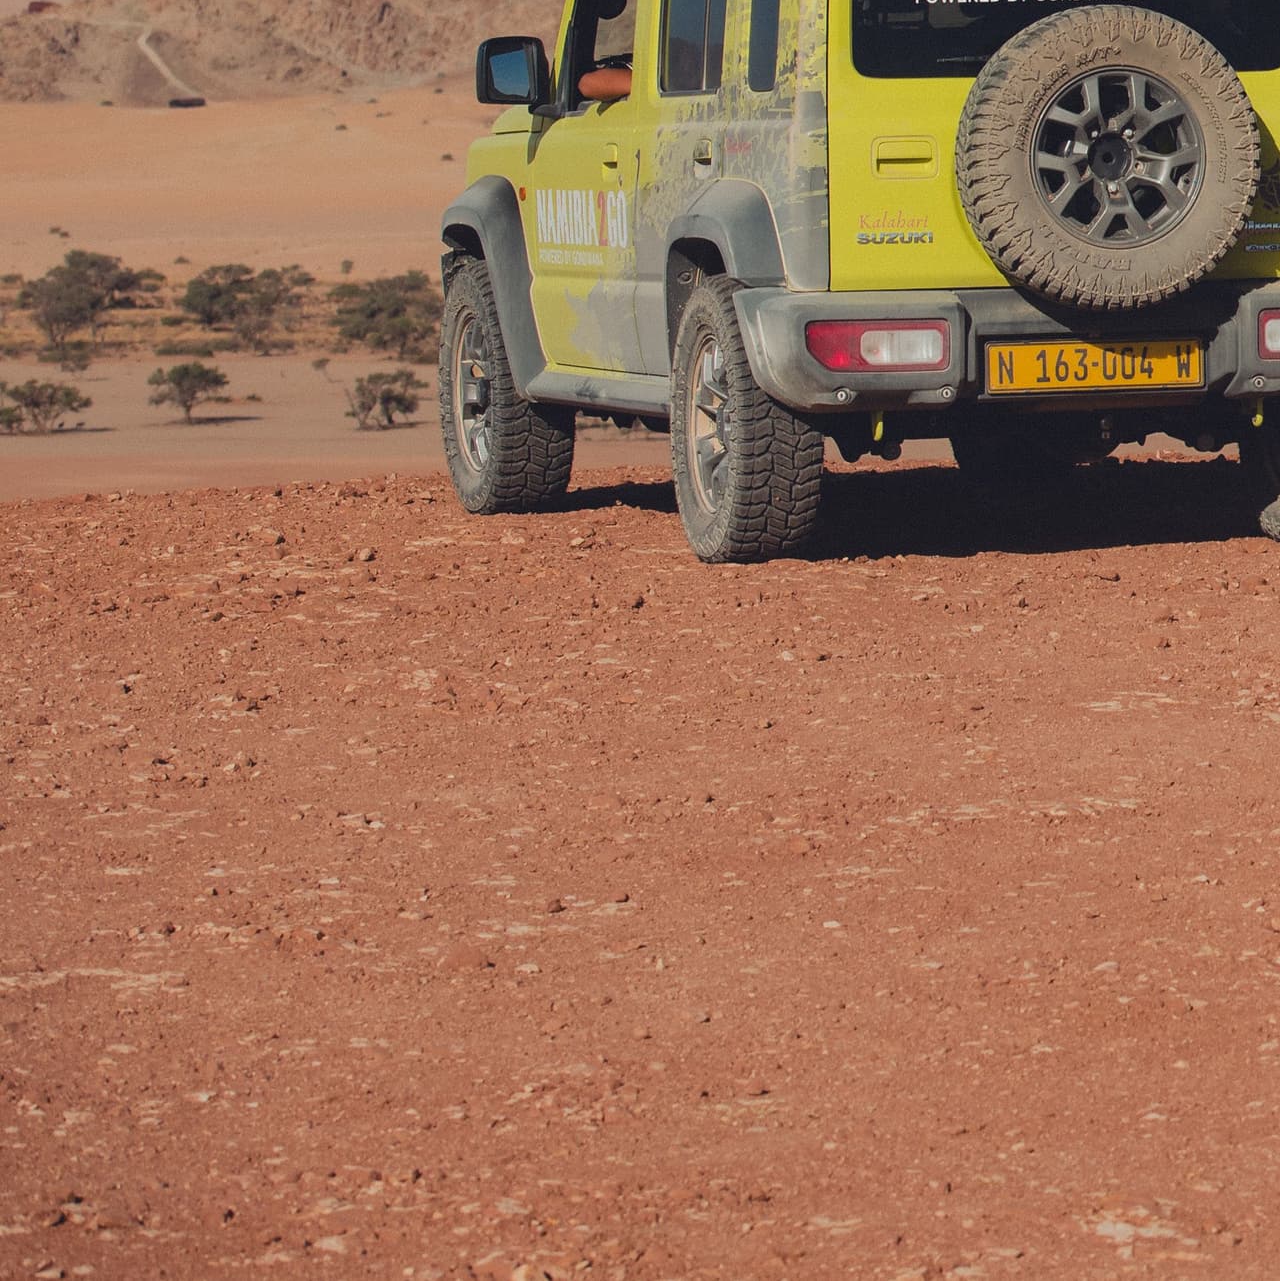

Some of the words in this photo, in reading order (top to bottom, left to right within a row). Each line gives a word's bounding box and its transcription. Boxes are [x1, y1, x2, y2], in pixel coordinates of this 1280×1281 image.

[536, 189, 628, 248] NAMIBIA2GO
[859, 210, 929, 229] Kalahari
[857, 232, 934, 245] SUZUKI
[998, 350, 1014, 384] N
[1036, 346, 1154, 383] 163-004
[1176, 345, 1191, 378] W
